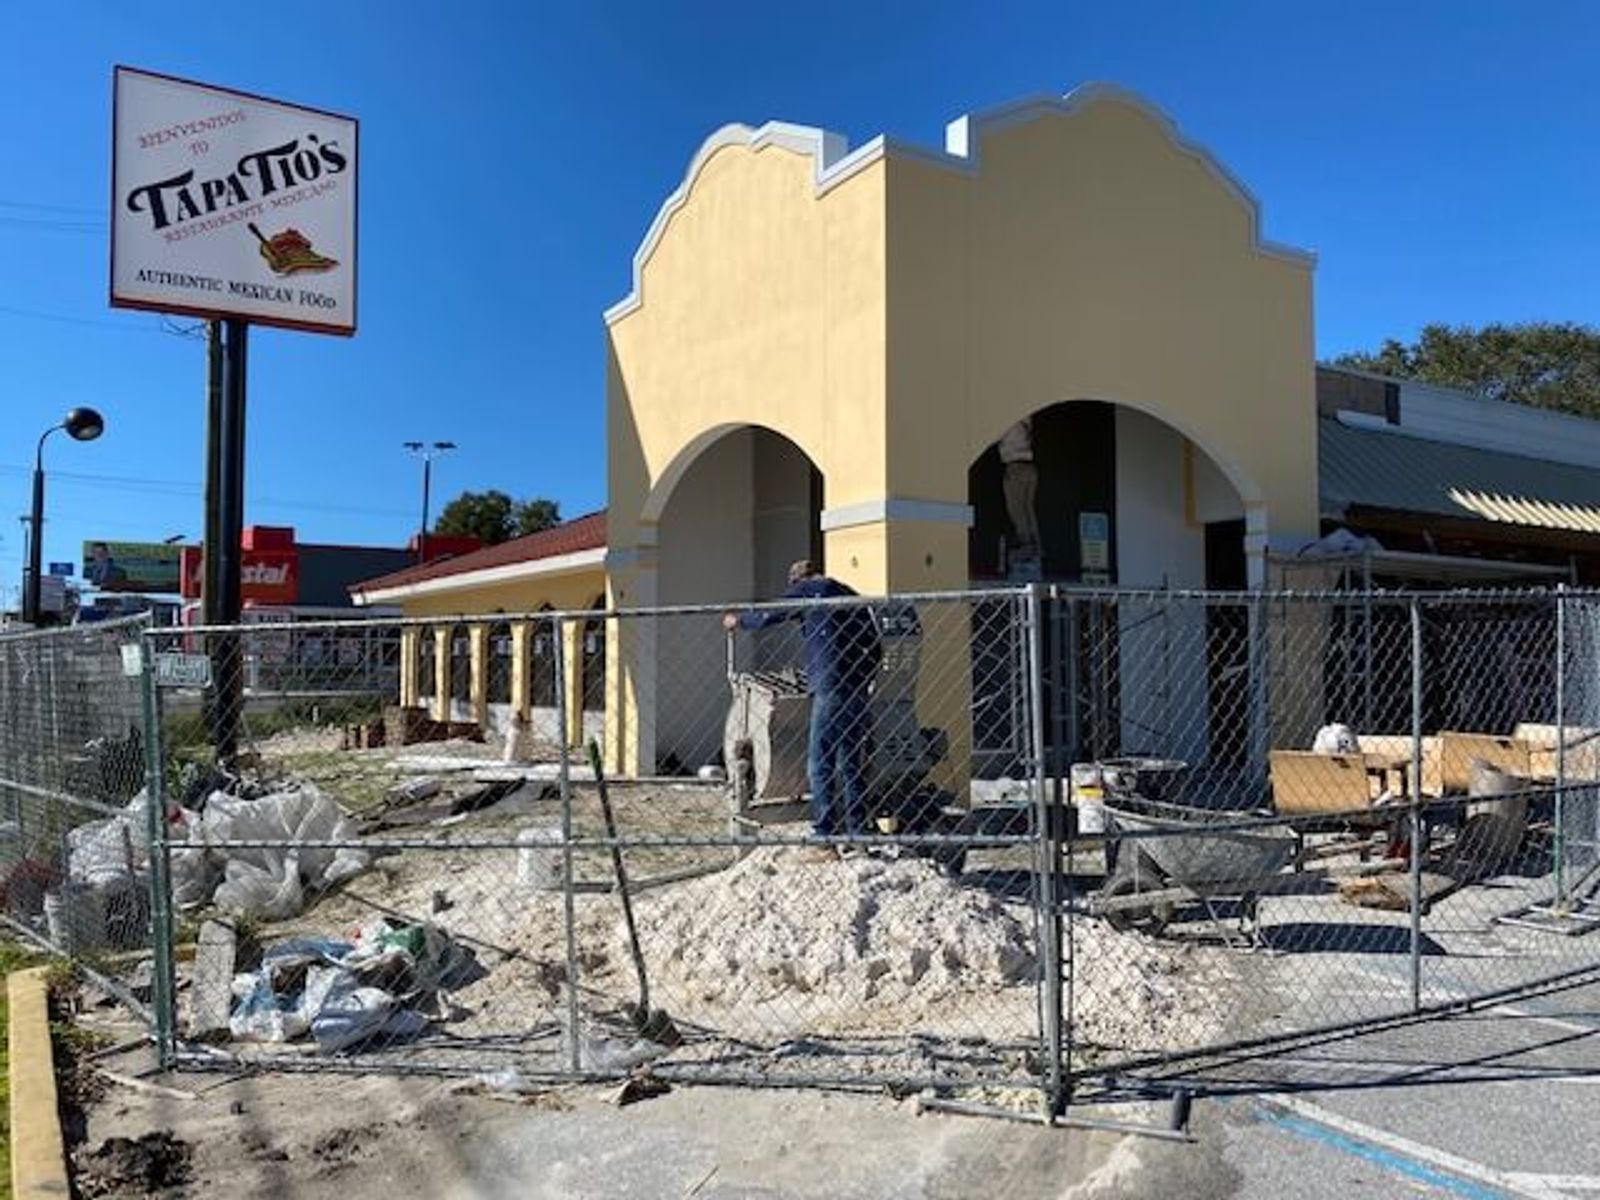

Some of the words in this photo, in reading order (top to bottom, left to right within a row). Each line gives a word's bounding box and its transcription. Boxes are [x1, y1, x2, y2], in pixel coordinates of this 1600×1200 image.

[190, 140, 209, 155] TO
[136, 269, 223, 292] AUTHENTIC
[228, 281, 293, 302] MEXICAN
[300, 290, 337, 309] FOOD
